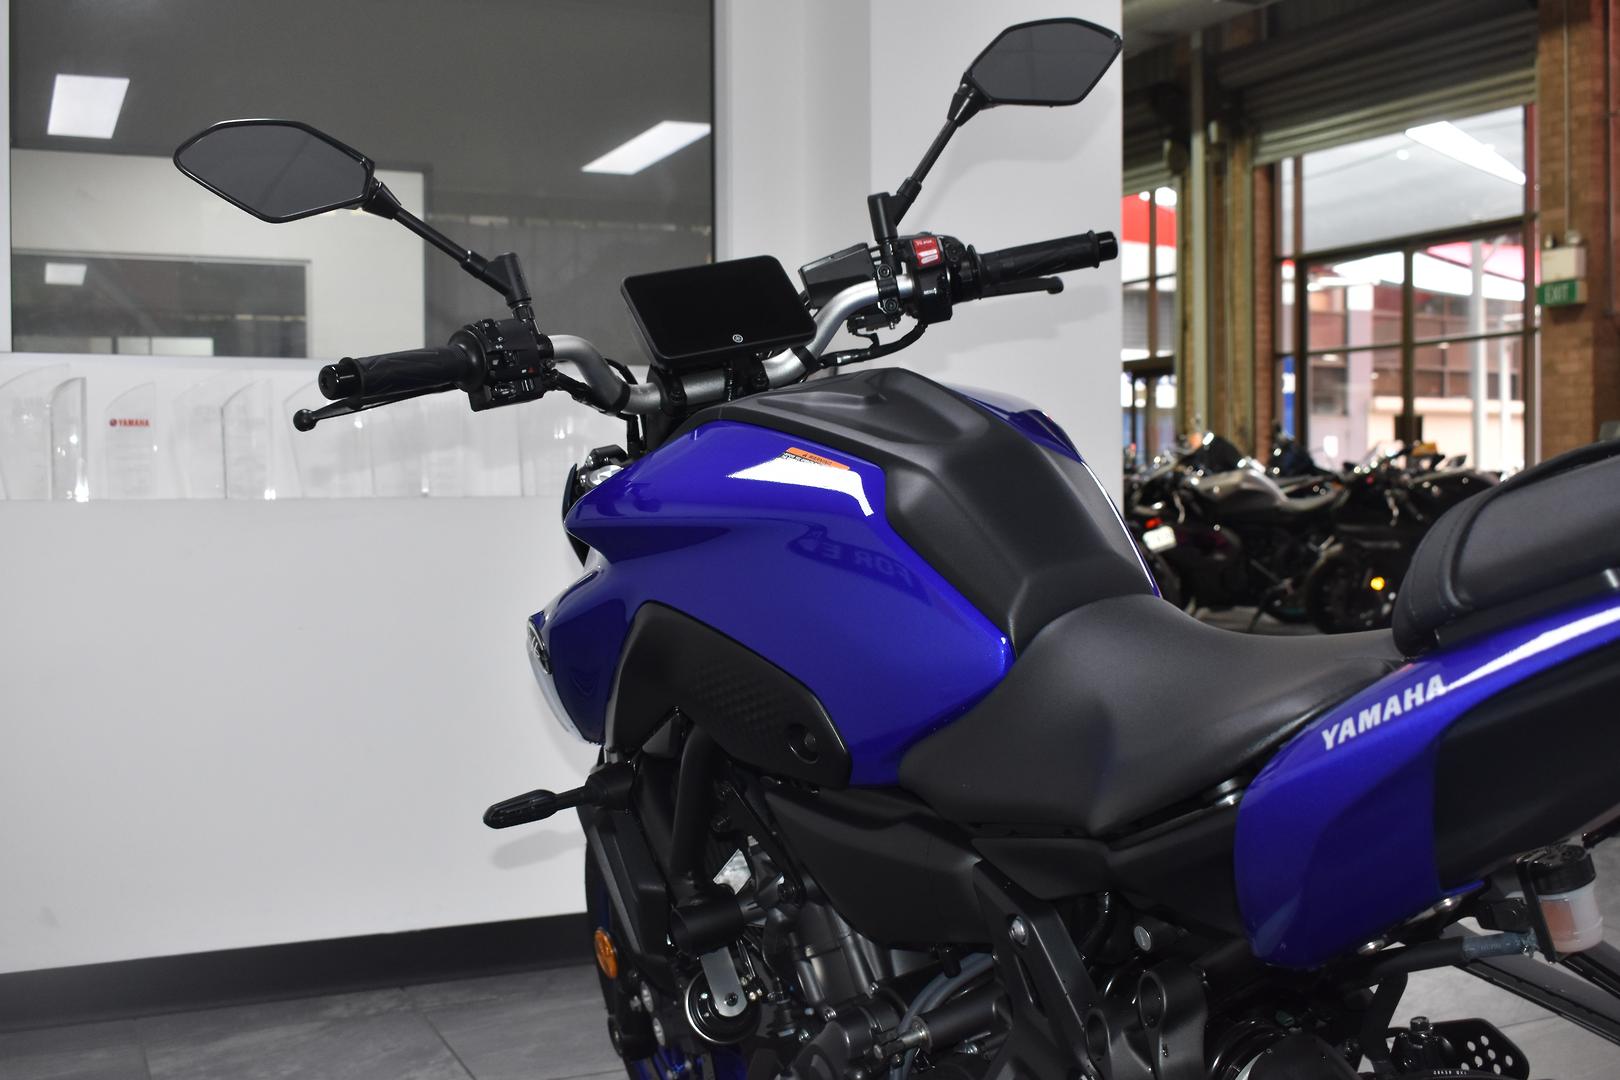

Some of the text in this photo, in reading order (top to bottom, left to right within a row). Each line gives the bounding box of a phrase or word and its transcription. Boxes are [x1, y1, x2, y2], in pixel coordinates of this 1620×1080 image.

[1544, 283, 1569, 303] EXIT
[118, 418, 150, 428] YAMAHA
[1322, 673, 1446, 751] YAMAHA
